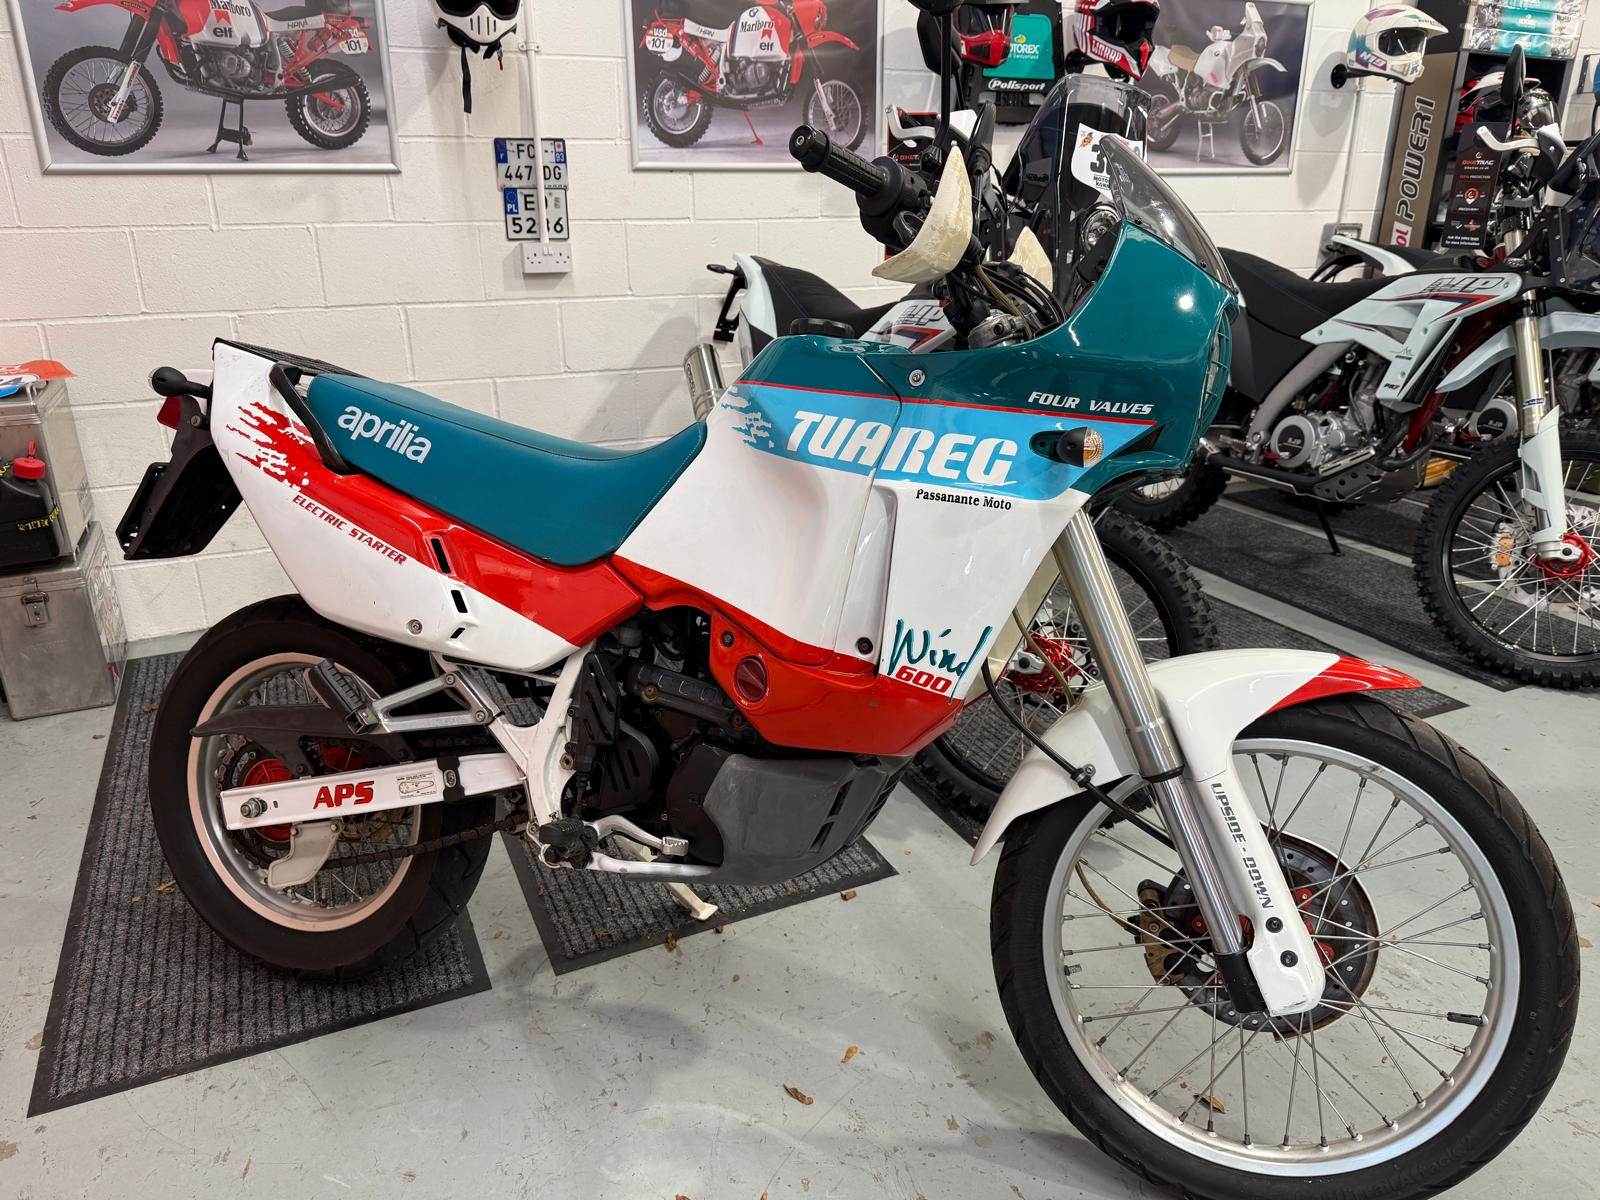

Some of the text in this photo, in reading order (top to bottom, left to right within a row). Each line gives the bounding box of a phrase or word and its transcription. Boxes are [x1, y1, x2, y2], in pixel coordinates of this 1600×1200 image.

[212, 27, 233, 38] elf
[739, 20, 775, 33] Marlboro
[344, 39, 362, 51] 101
[651, 38, 665, 49] 101
[759, 42, 774, 51] elf
[988, 79, 1046, 91] Polisport
[1396, 96, 1435, 221] POWER1
[504, 165, 562, 180] 447 DG
[507, 204, 518, 212] PL
[1027, 391, 1154, 415] FOUR VALVES
[338, 405, 432, 464] aprilia
[787, 410, 1018, 485] TUAREG
[915, 488, 1012, 511] Passanante Moto
[292, 494, 408, 566] ELECTRIC STARTER
[886, 618, 993, 704] Wind
[895, 665, 953, 694] 600
[313, 781, 375, 810] APS
[1210, 782, 1247, 844] UPSIDE
[1242, 856, 1274, 909] DOWN
